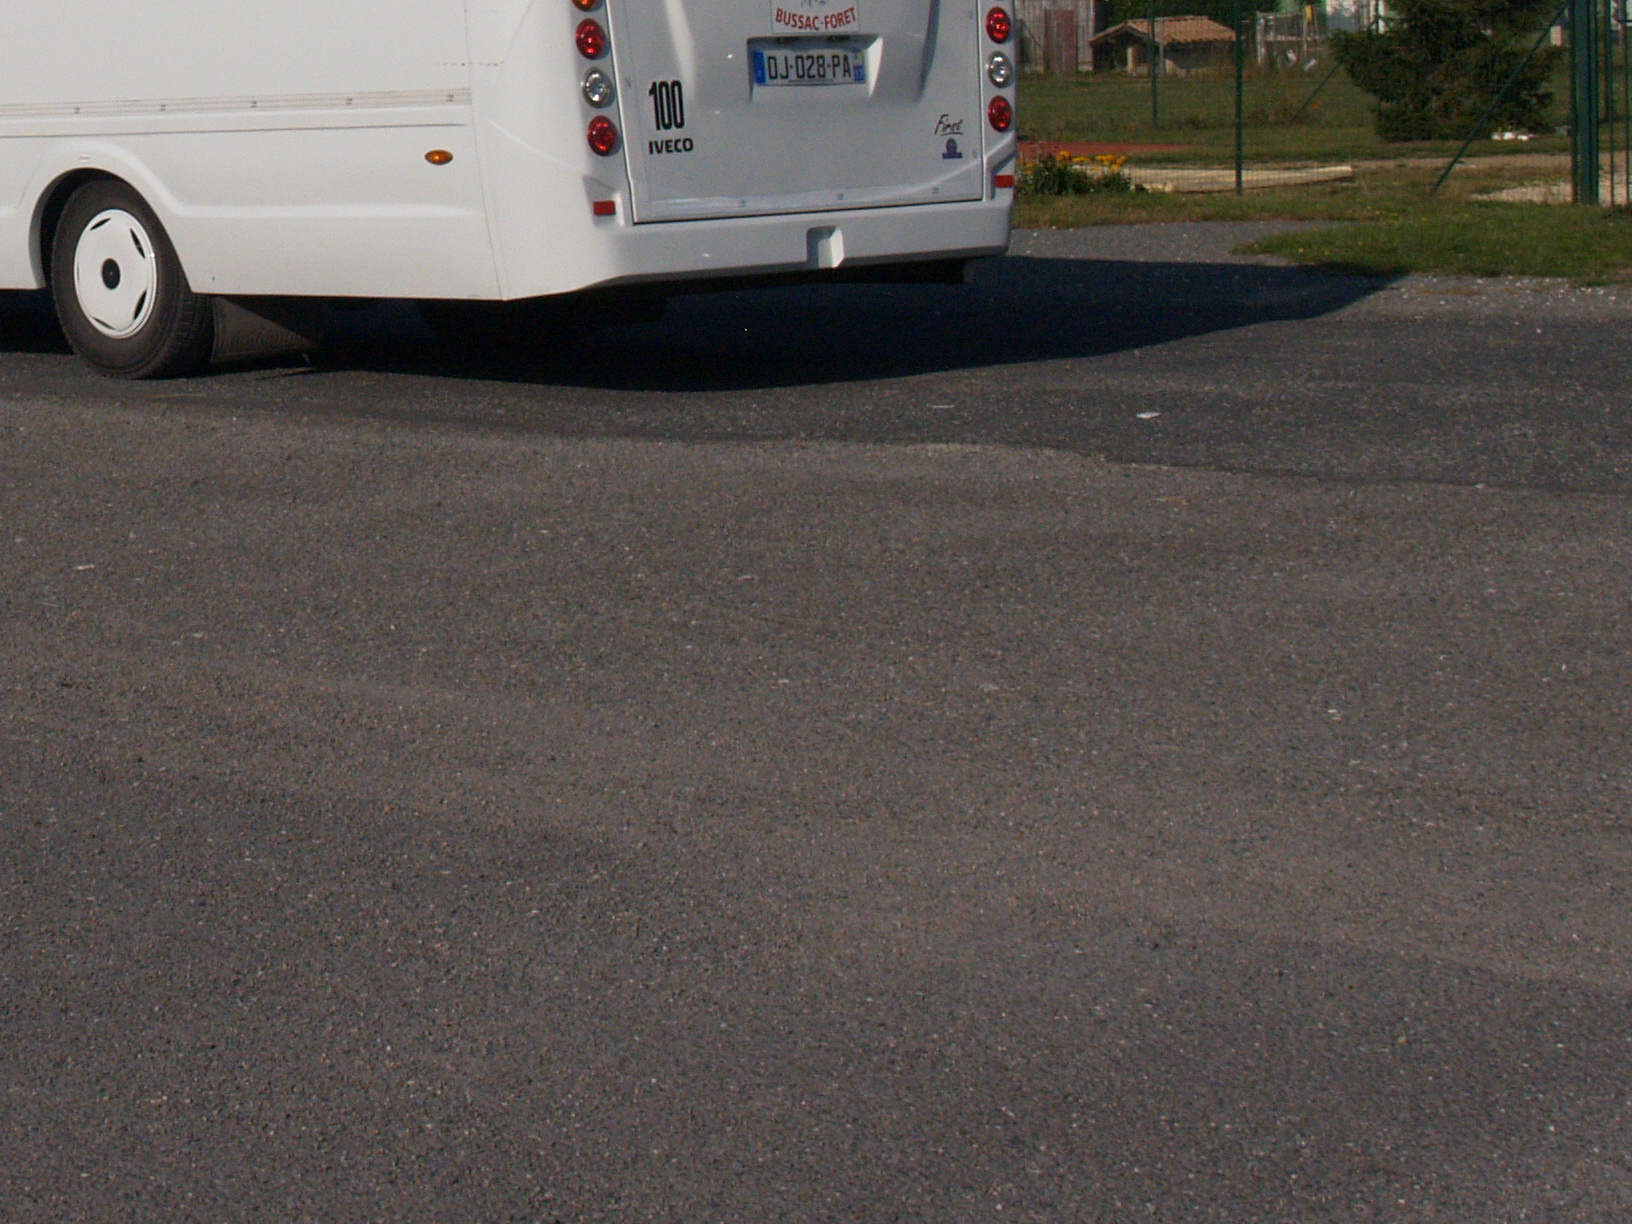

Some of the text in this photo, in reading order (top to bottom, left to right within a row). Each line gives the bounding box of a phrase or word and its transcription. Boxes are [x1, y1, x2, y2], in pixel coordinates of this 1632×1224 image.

[767, 53, 852, 81] DJ-028-PA
[648, 79, 685, 131] 100
[648, 137, 694, 155] IVECO
